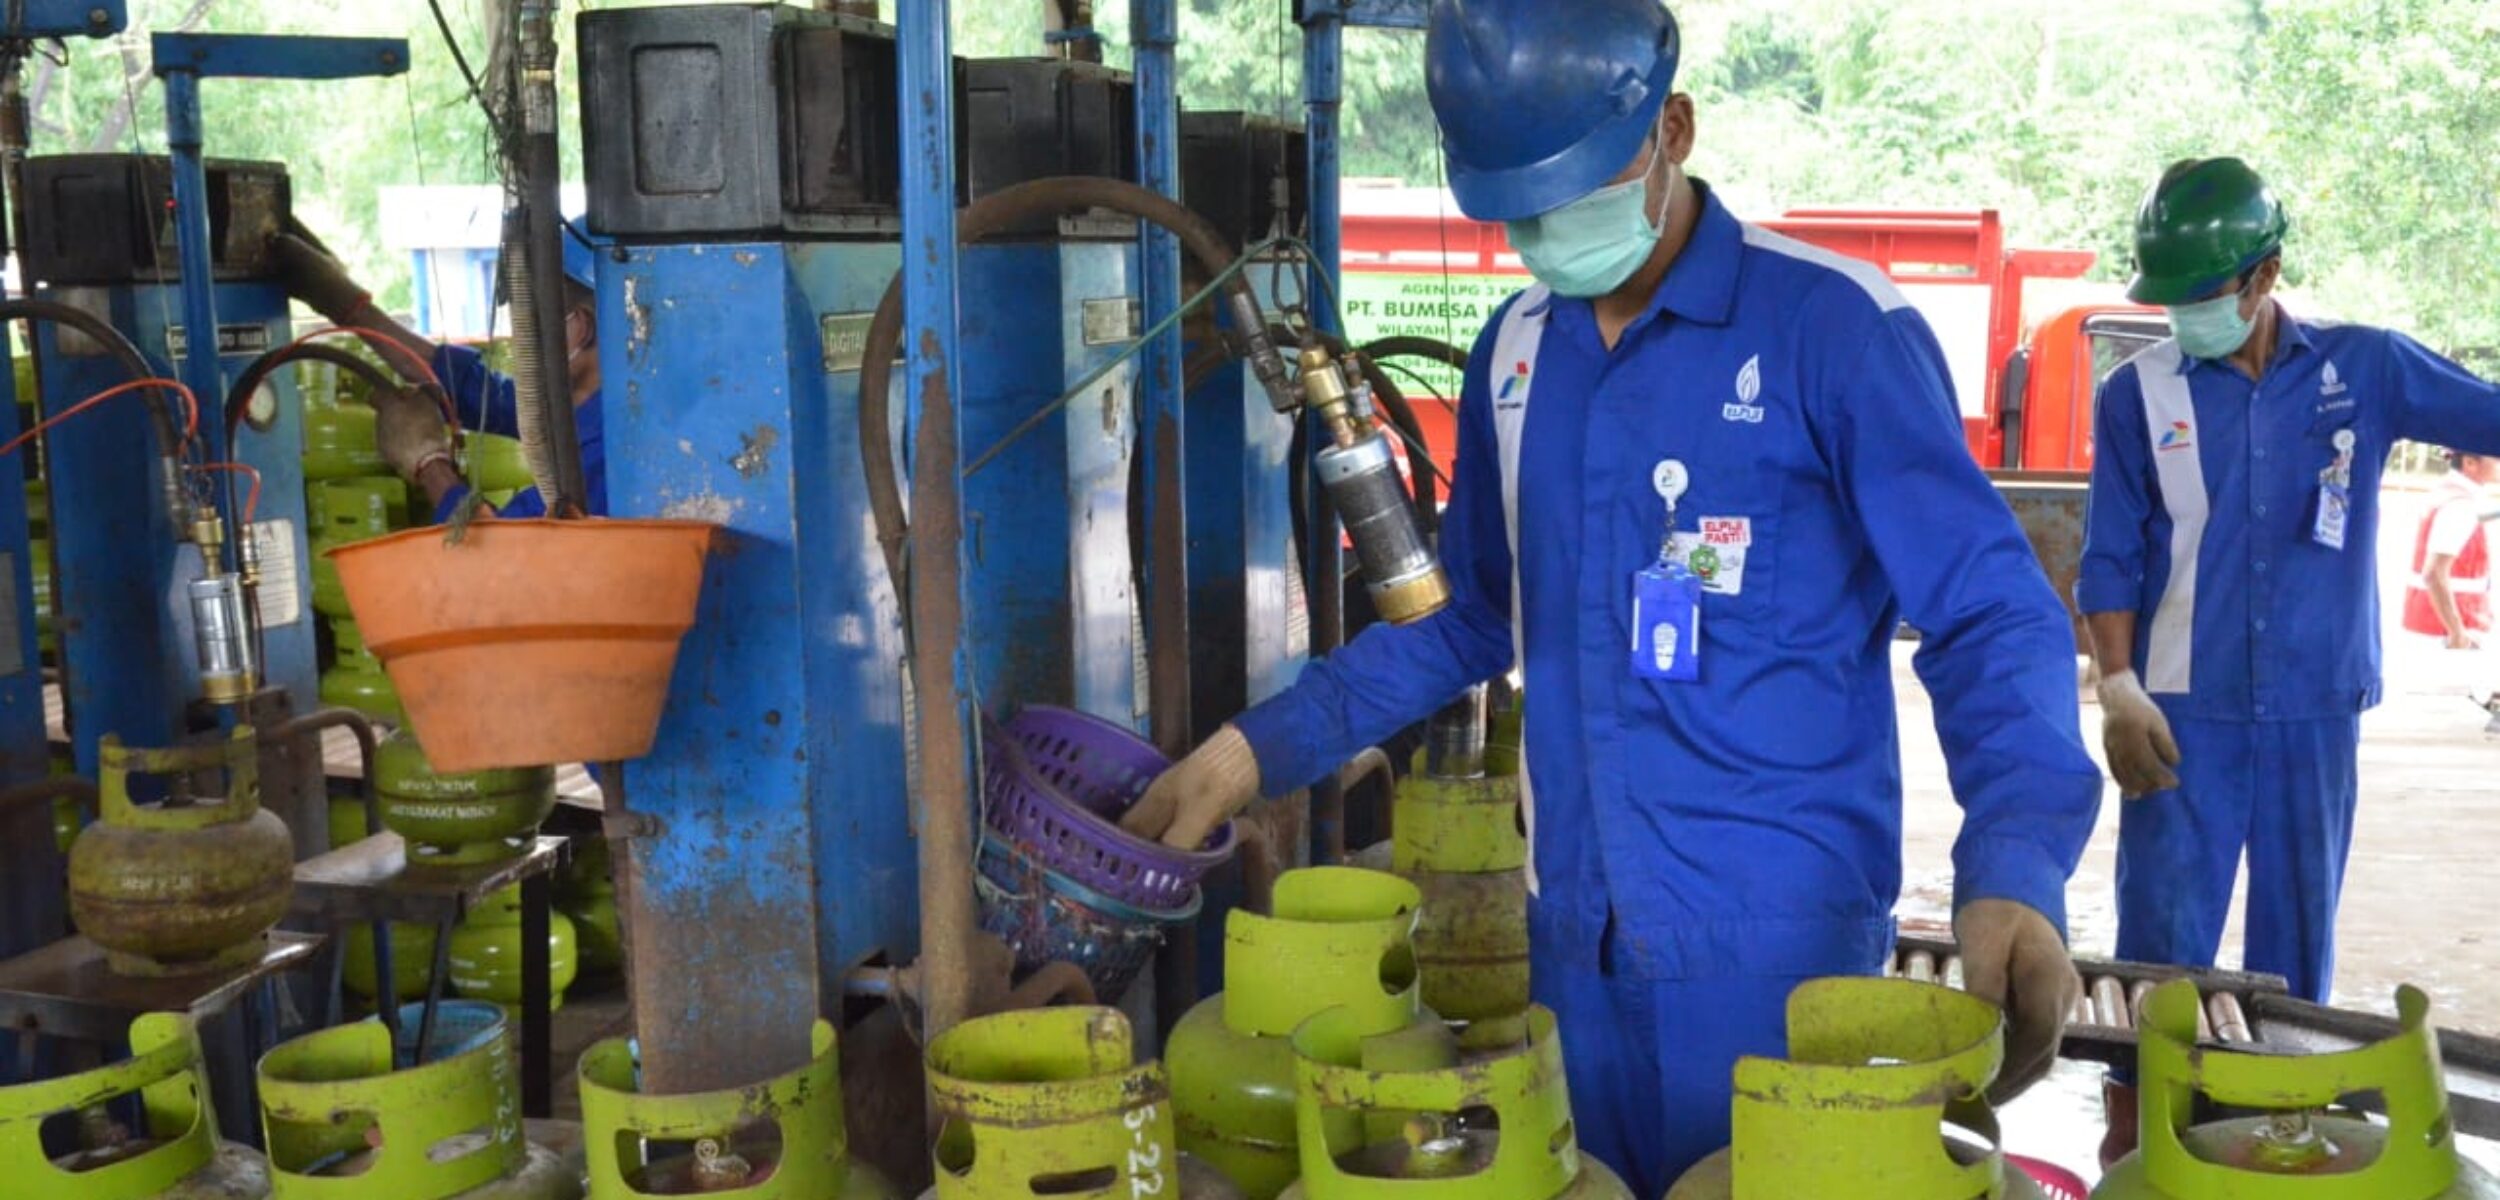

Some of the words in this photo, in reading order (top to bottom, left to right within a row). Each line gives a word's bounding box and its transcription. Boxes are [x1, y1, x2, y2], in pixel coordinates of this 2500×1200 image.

[1401, 283, 1445, 295] AGEN
[1450, 285, 1480, 296] LPG
[1384, 301, 1478, 318] BUMESA
